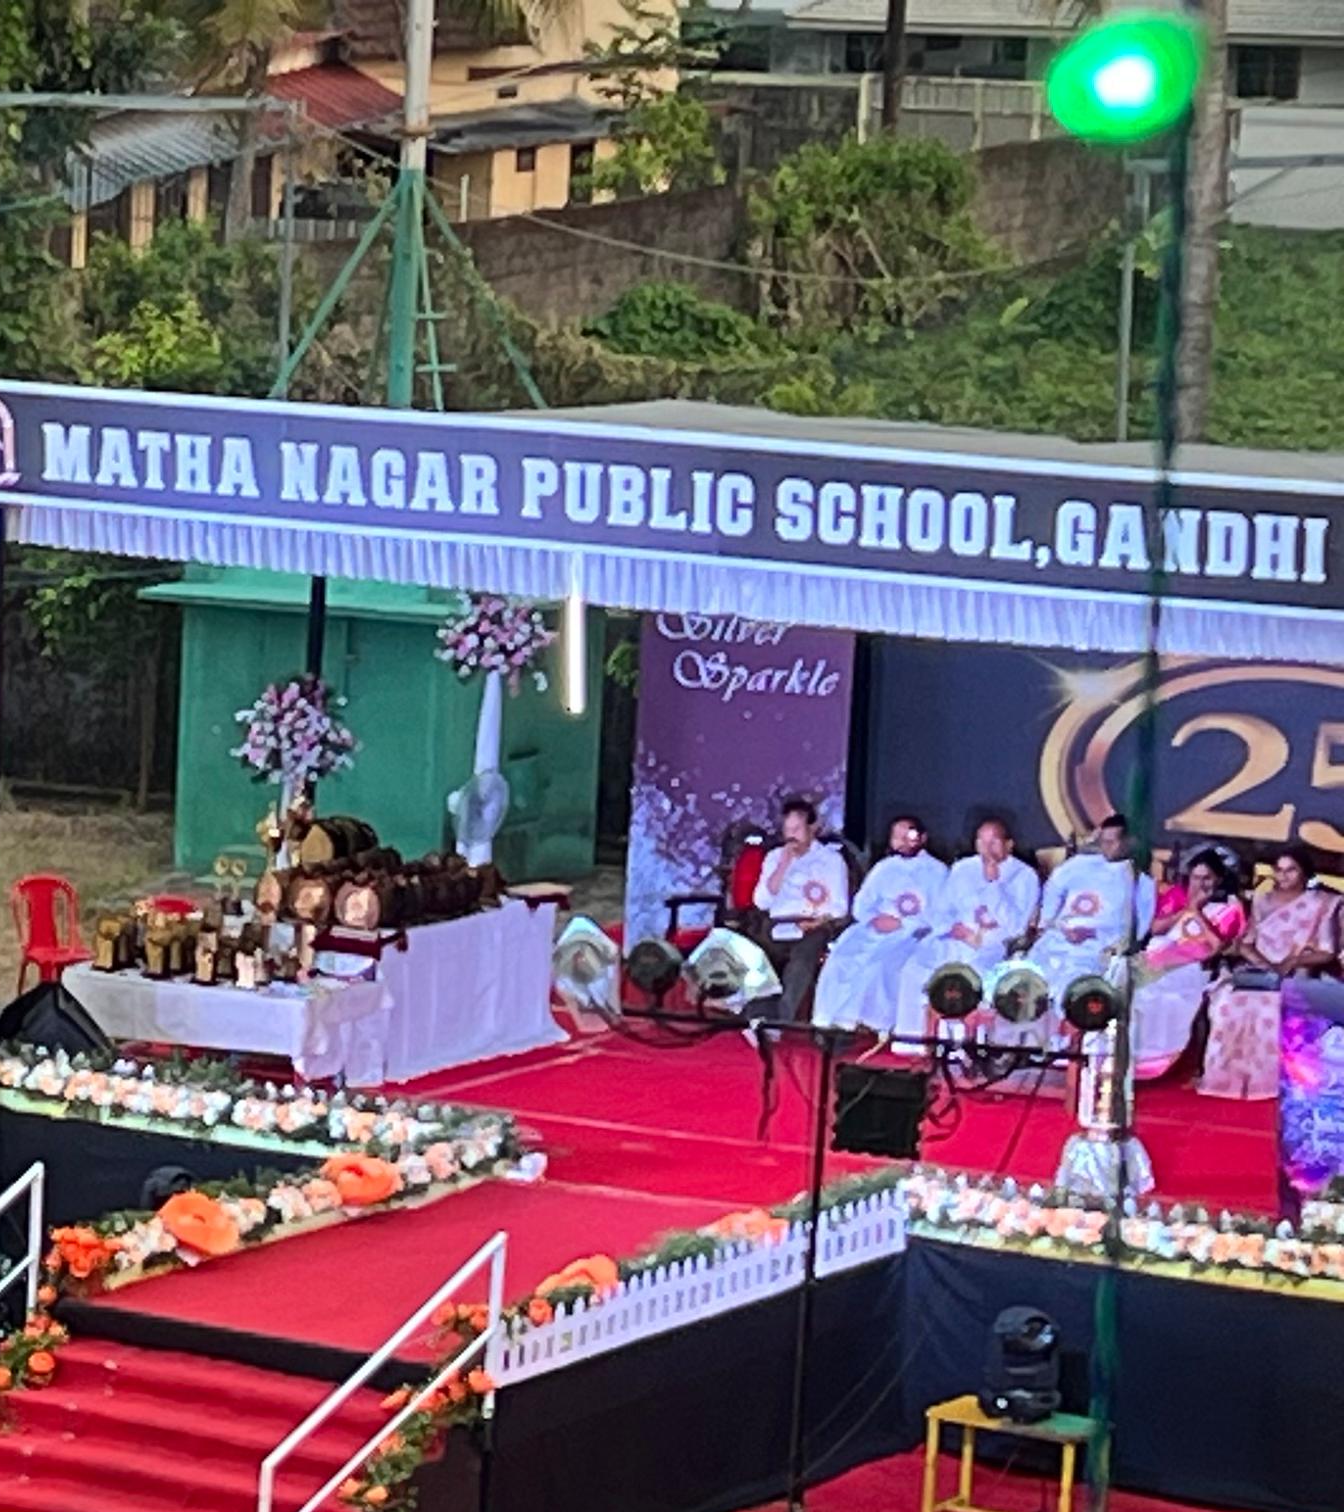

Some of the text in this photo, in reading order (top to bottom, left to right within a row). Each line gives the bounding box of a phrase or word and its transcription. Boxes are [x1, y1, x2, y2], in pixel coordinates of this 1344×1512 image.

[40, 421, 260, 499] MATHA
[280, 441, 500, 517] NAGAR
[520, 455, 755, 537] PUBLIC
[673, 649, 841, 702] Sparkle
